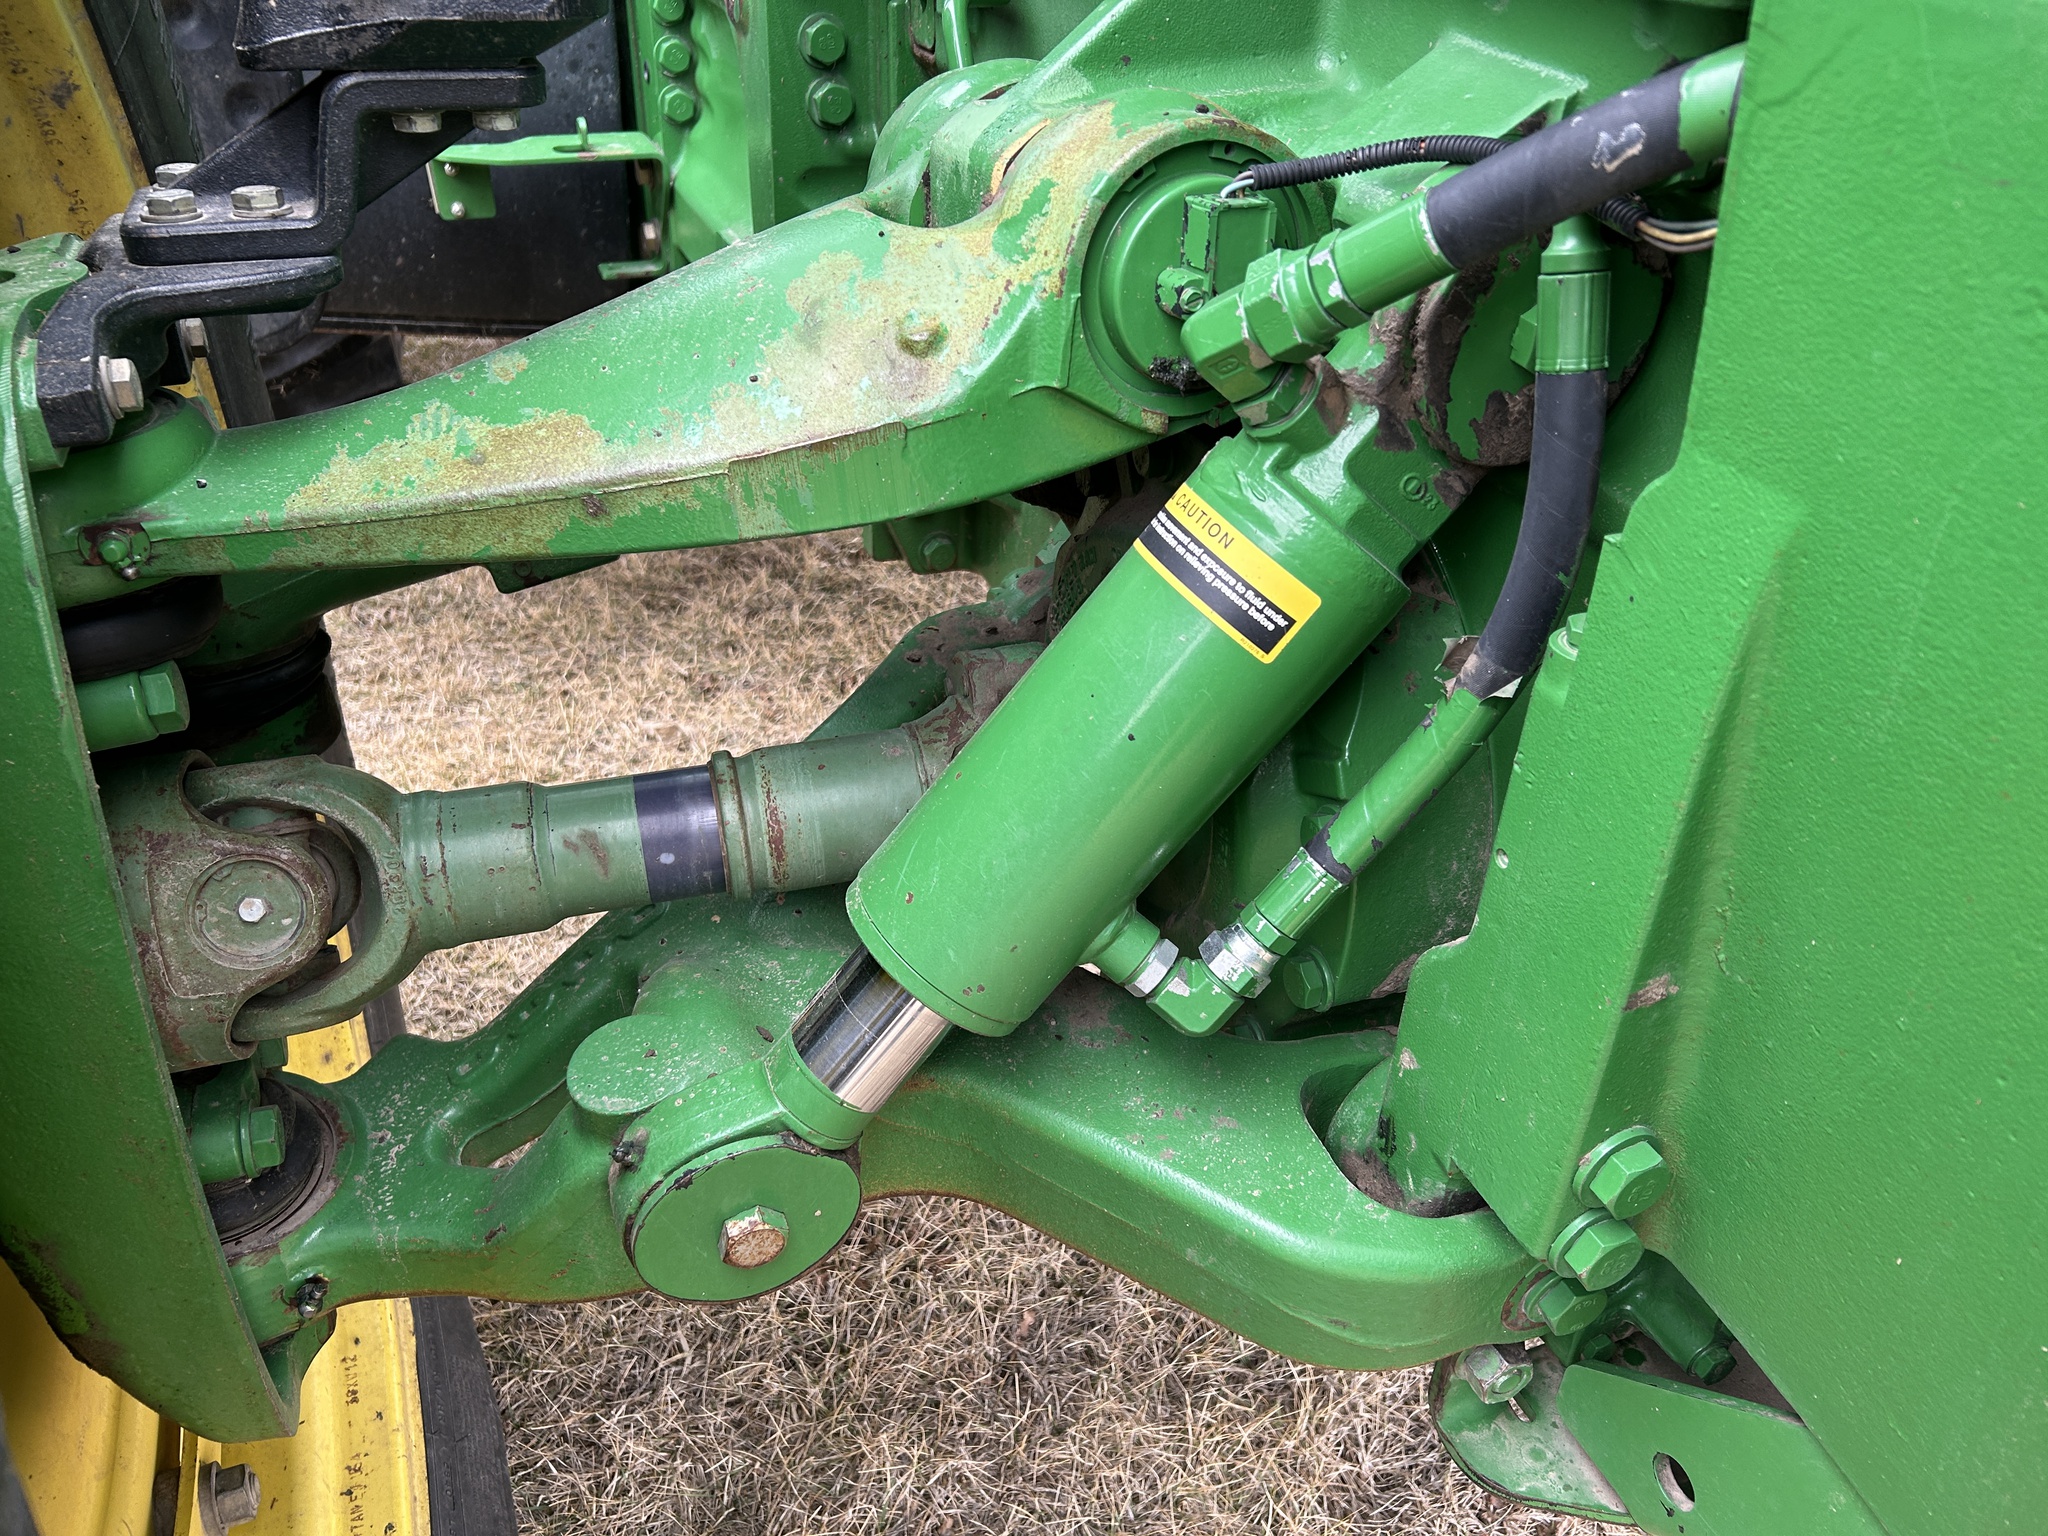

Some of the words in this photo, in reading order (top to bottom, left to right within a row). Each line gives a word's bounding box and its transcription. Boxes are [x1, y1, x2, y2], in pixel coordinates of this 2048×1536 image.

[1176, 493, 1235, 549] CAUTION
[1175, 544, 1186, 556] on
[1183, 551, 1215, 583] relieving
[1211, 578, 1250, 611] pressure
[1247, 606, 1275, 632] before
[1187, 541, 1205, 557] and
[1200, 553, 1237, 586] exposure
[1235, 582, 1246, 594] to
[1244, 590, 1267, 610] fluid
[1263, 606, 1289, 627] under
